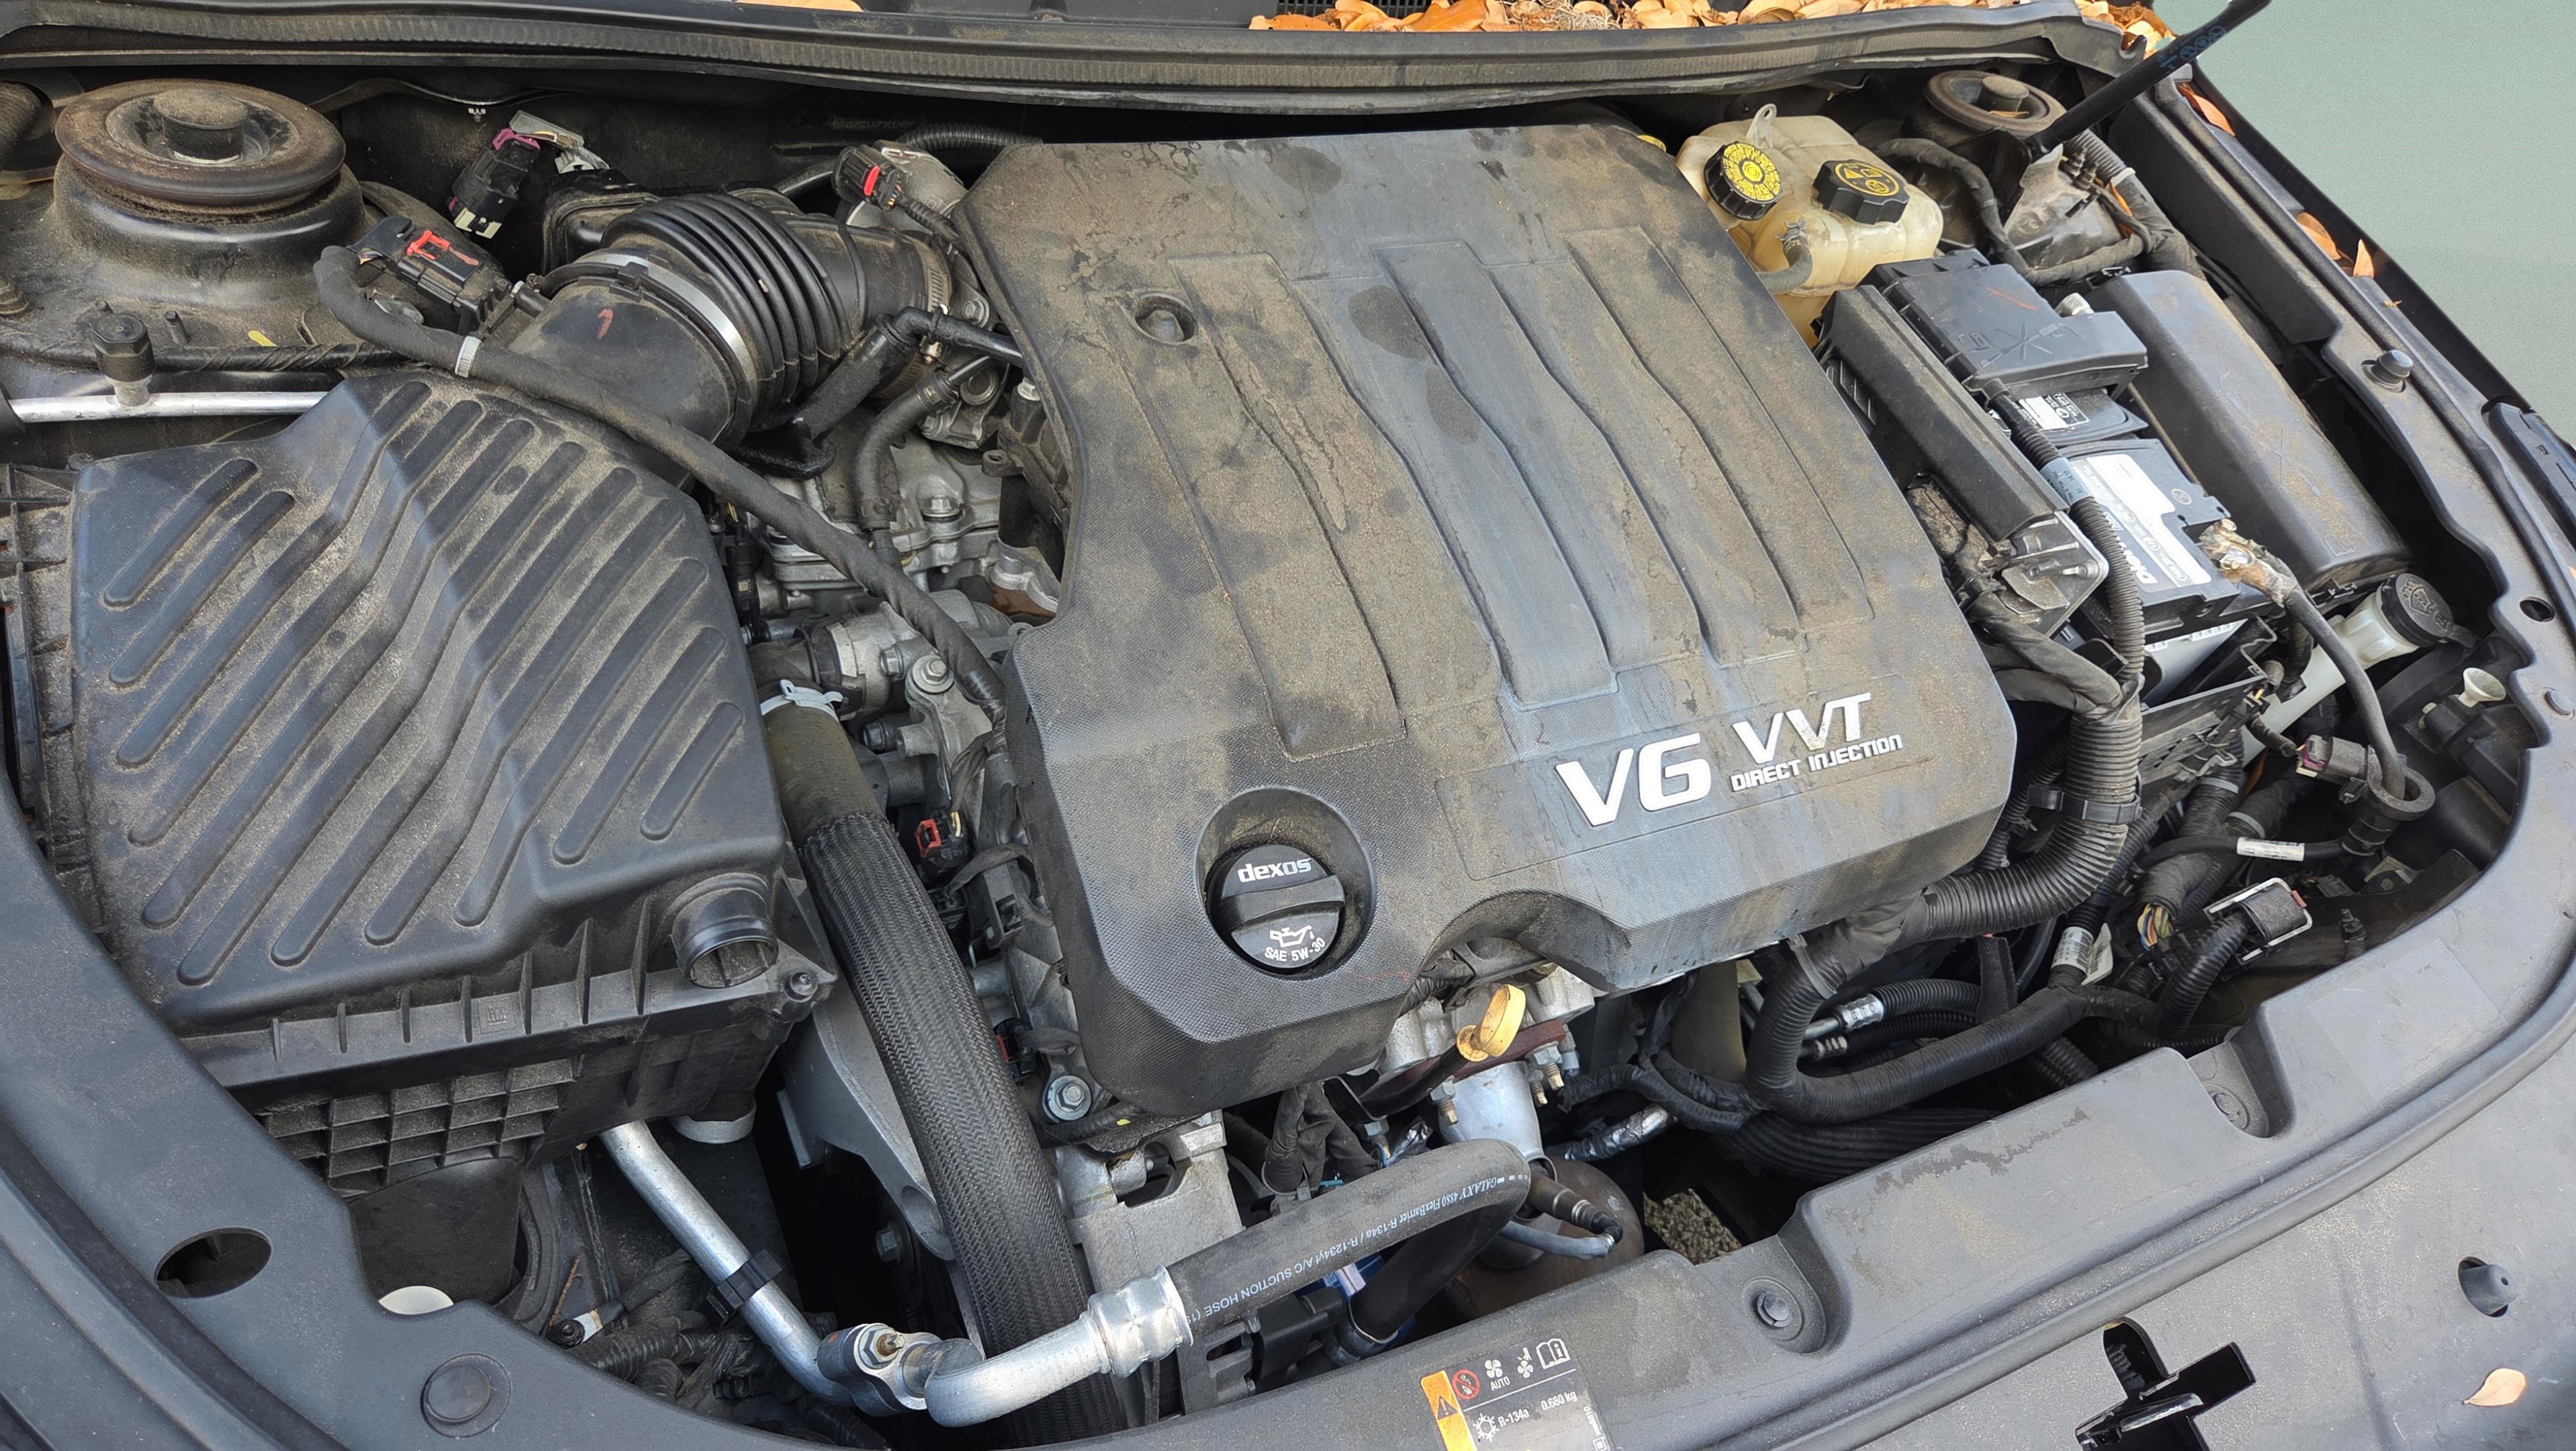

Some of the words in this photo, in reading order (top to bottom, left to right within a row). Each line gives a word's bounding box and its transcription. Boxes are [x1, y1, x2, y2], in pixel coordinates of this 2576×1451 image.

[1555, 732, 1712, 828] V6
[1732, 691, 1872, 765] VVT
[1730, 759, 1801, 792] DIRECT
[1807, 734, 1904, 772] INJECTION
[1237, 858, 1312, 883] dexos
[1264, 946, 1287, 962] SAE
[1291, 937, 1326, 962] 5W-30
[1459, 1176, 1497, 1200] GALAXY
[1399, 1198, 1440, 1224] FlexBarrier
[1360, 1232, 1364, 1243] /
[1365, 1218, 1397, 1238] R-134a
[1315, 1236, 1359, 1264] R-1234yf
[1294, 1256, 1314, 1274] A/C
[1240, 1268, 1292, 1299] SUCTION
[1203, 1292, 1239, 1317] HOSE
[1489, 1376, 1510, 1391] AUTO
[1497, 1408, 1530, 1427] R-134a
[1540, 1393, 1565, 1411] 0.680
[1565, 1390, 1578, 1403] kg
